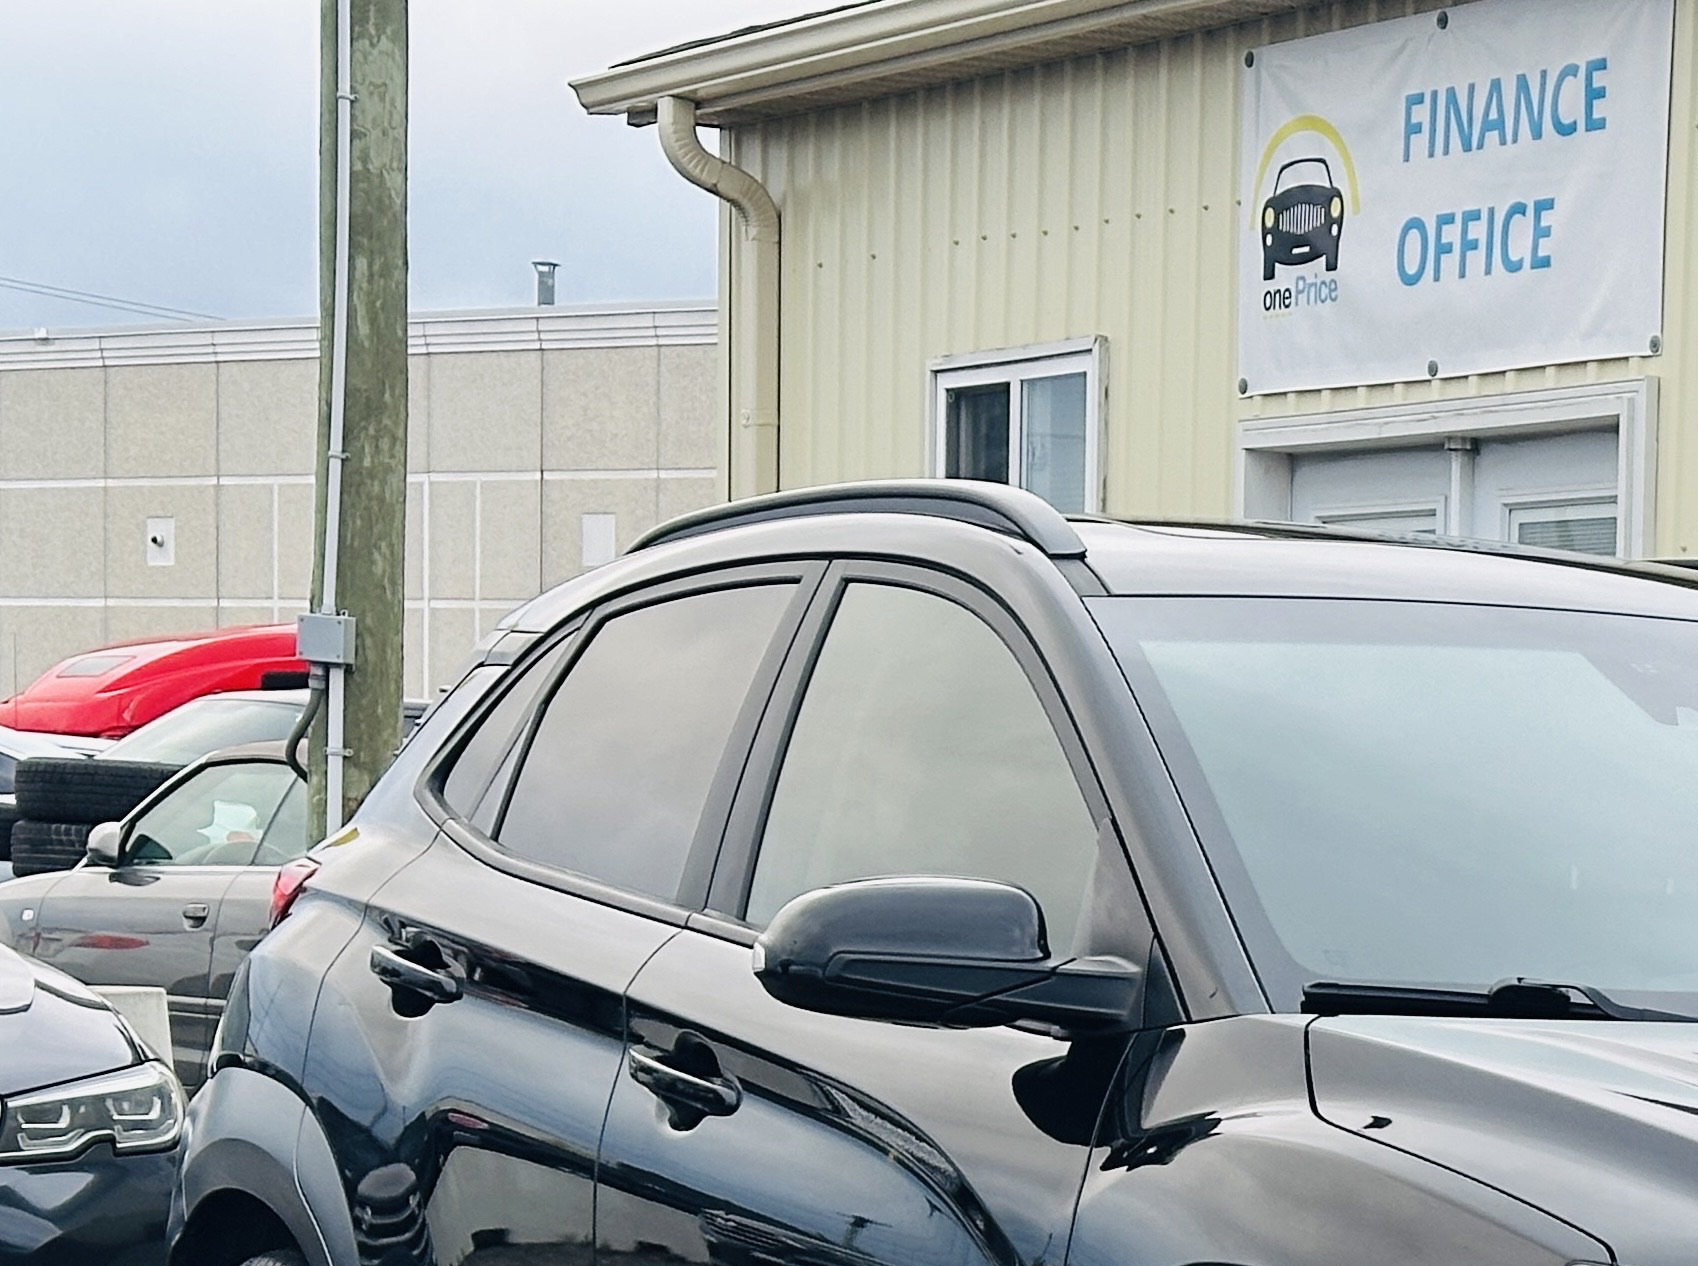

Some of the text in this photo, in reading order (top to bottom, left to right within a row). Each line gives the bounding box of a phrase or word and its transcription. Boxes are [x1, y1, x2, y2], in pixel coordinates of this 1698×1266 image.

[1402, 57, 1607, 163] FINANCE
[1396, 197, 1555, 287] OFFICE
[1263, 272, 1338, 312] one Price
